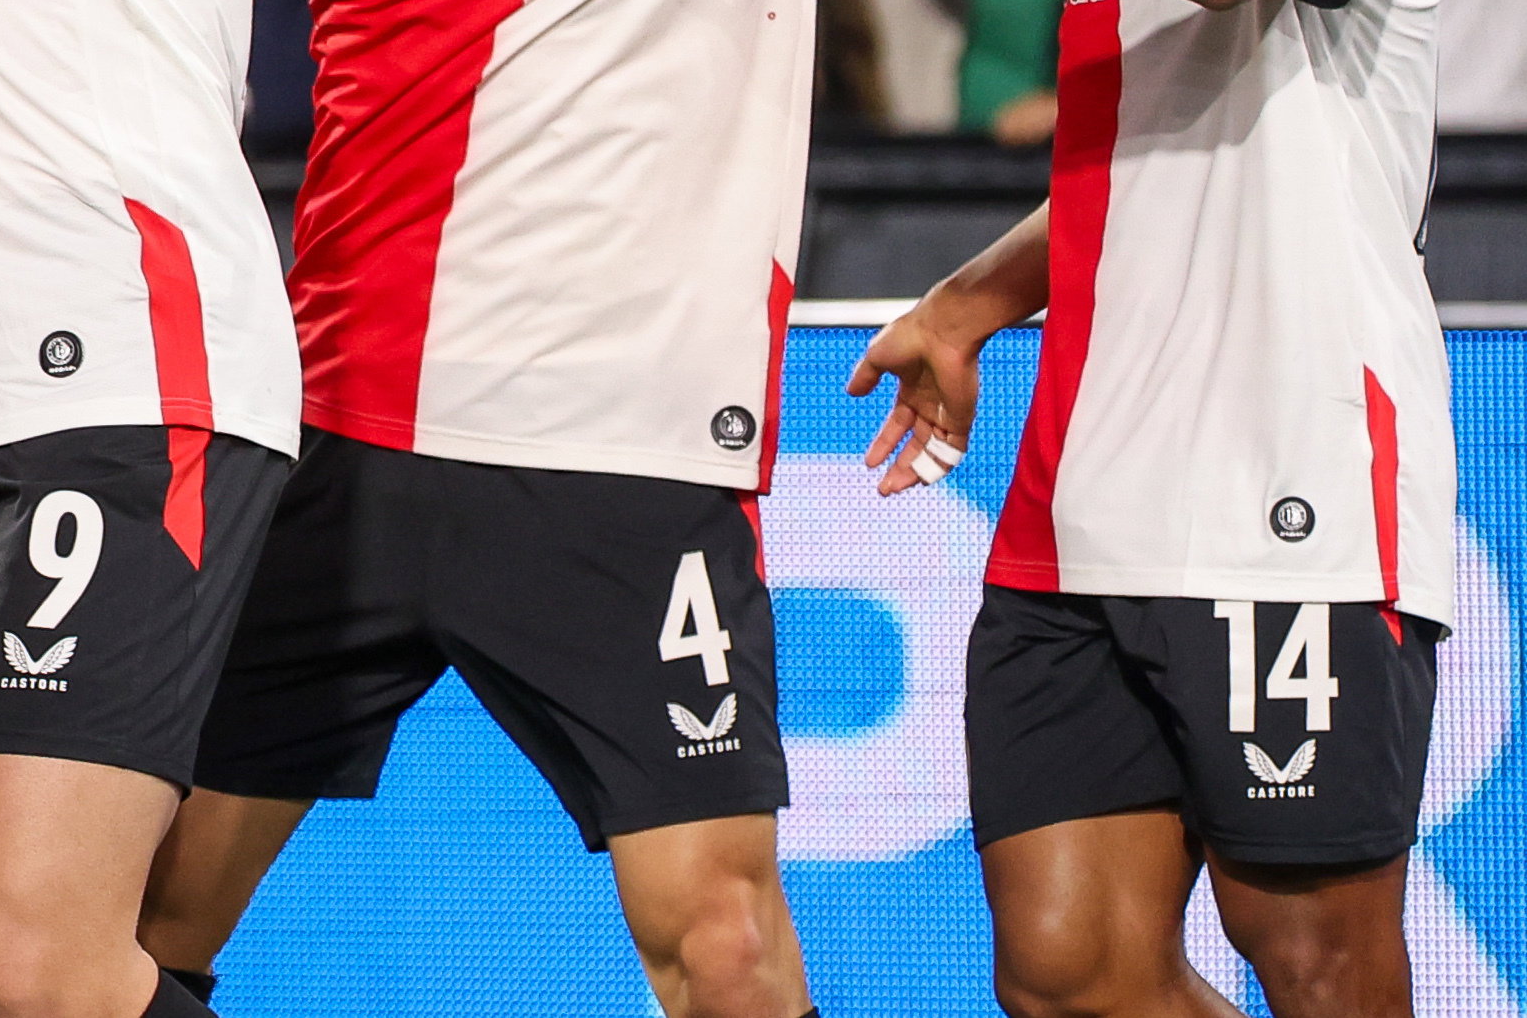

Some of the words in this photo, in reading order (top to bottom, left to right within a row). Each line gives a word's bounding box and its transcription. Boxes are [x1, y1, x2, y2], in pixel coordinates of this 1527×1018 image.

[26, 490, 104, 630] 9
[658, 551, 734, 687] 4
[0, 677, 68, 692] CASTORE
[1213, 601, 1340, 733] 14
[677, 738, 741, 759] CASTORE
[1247, 785, 1315, 799] CASTORE
